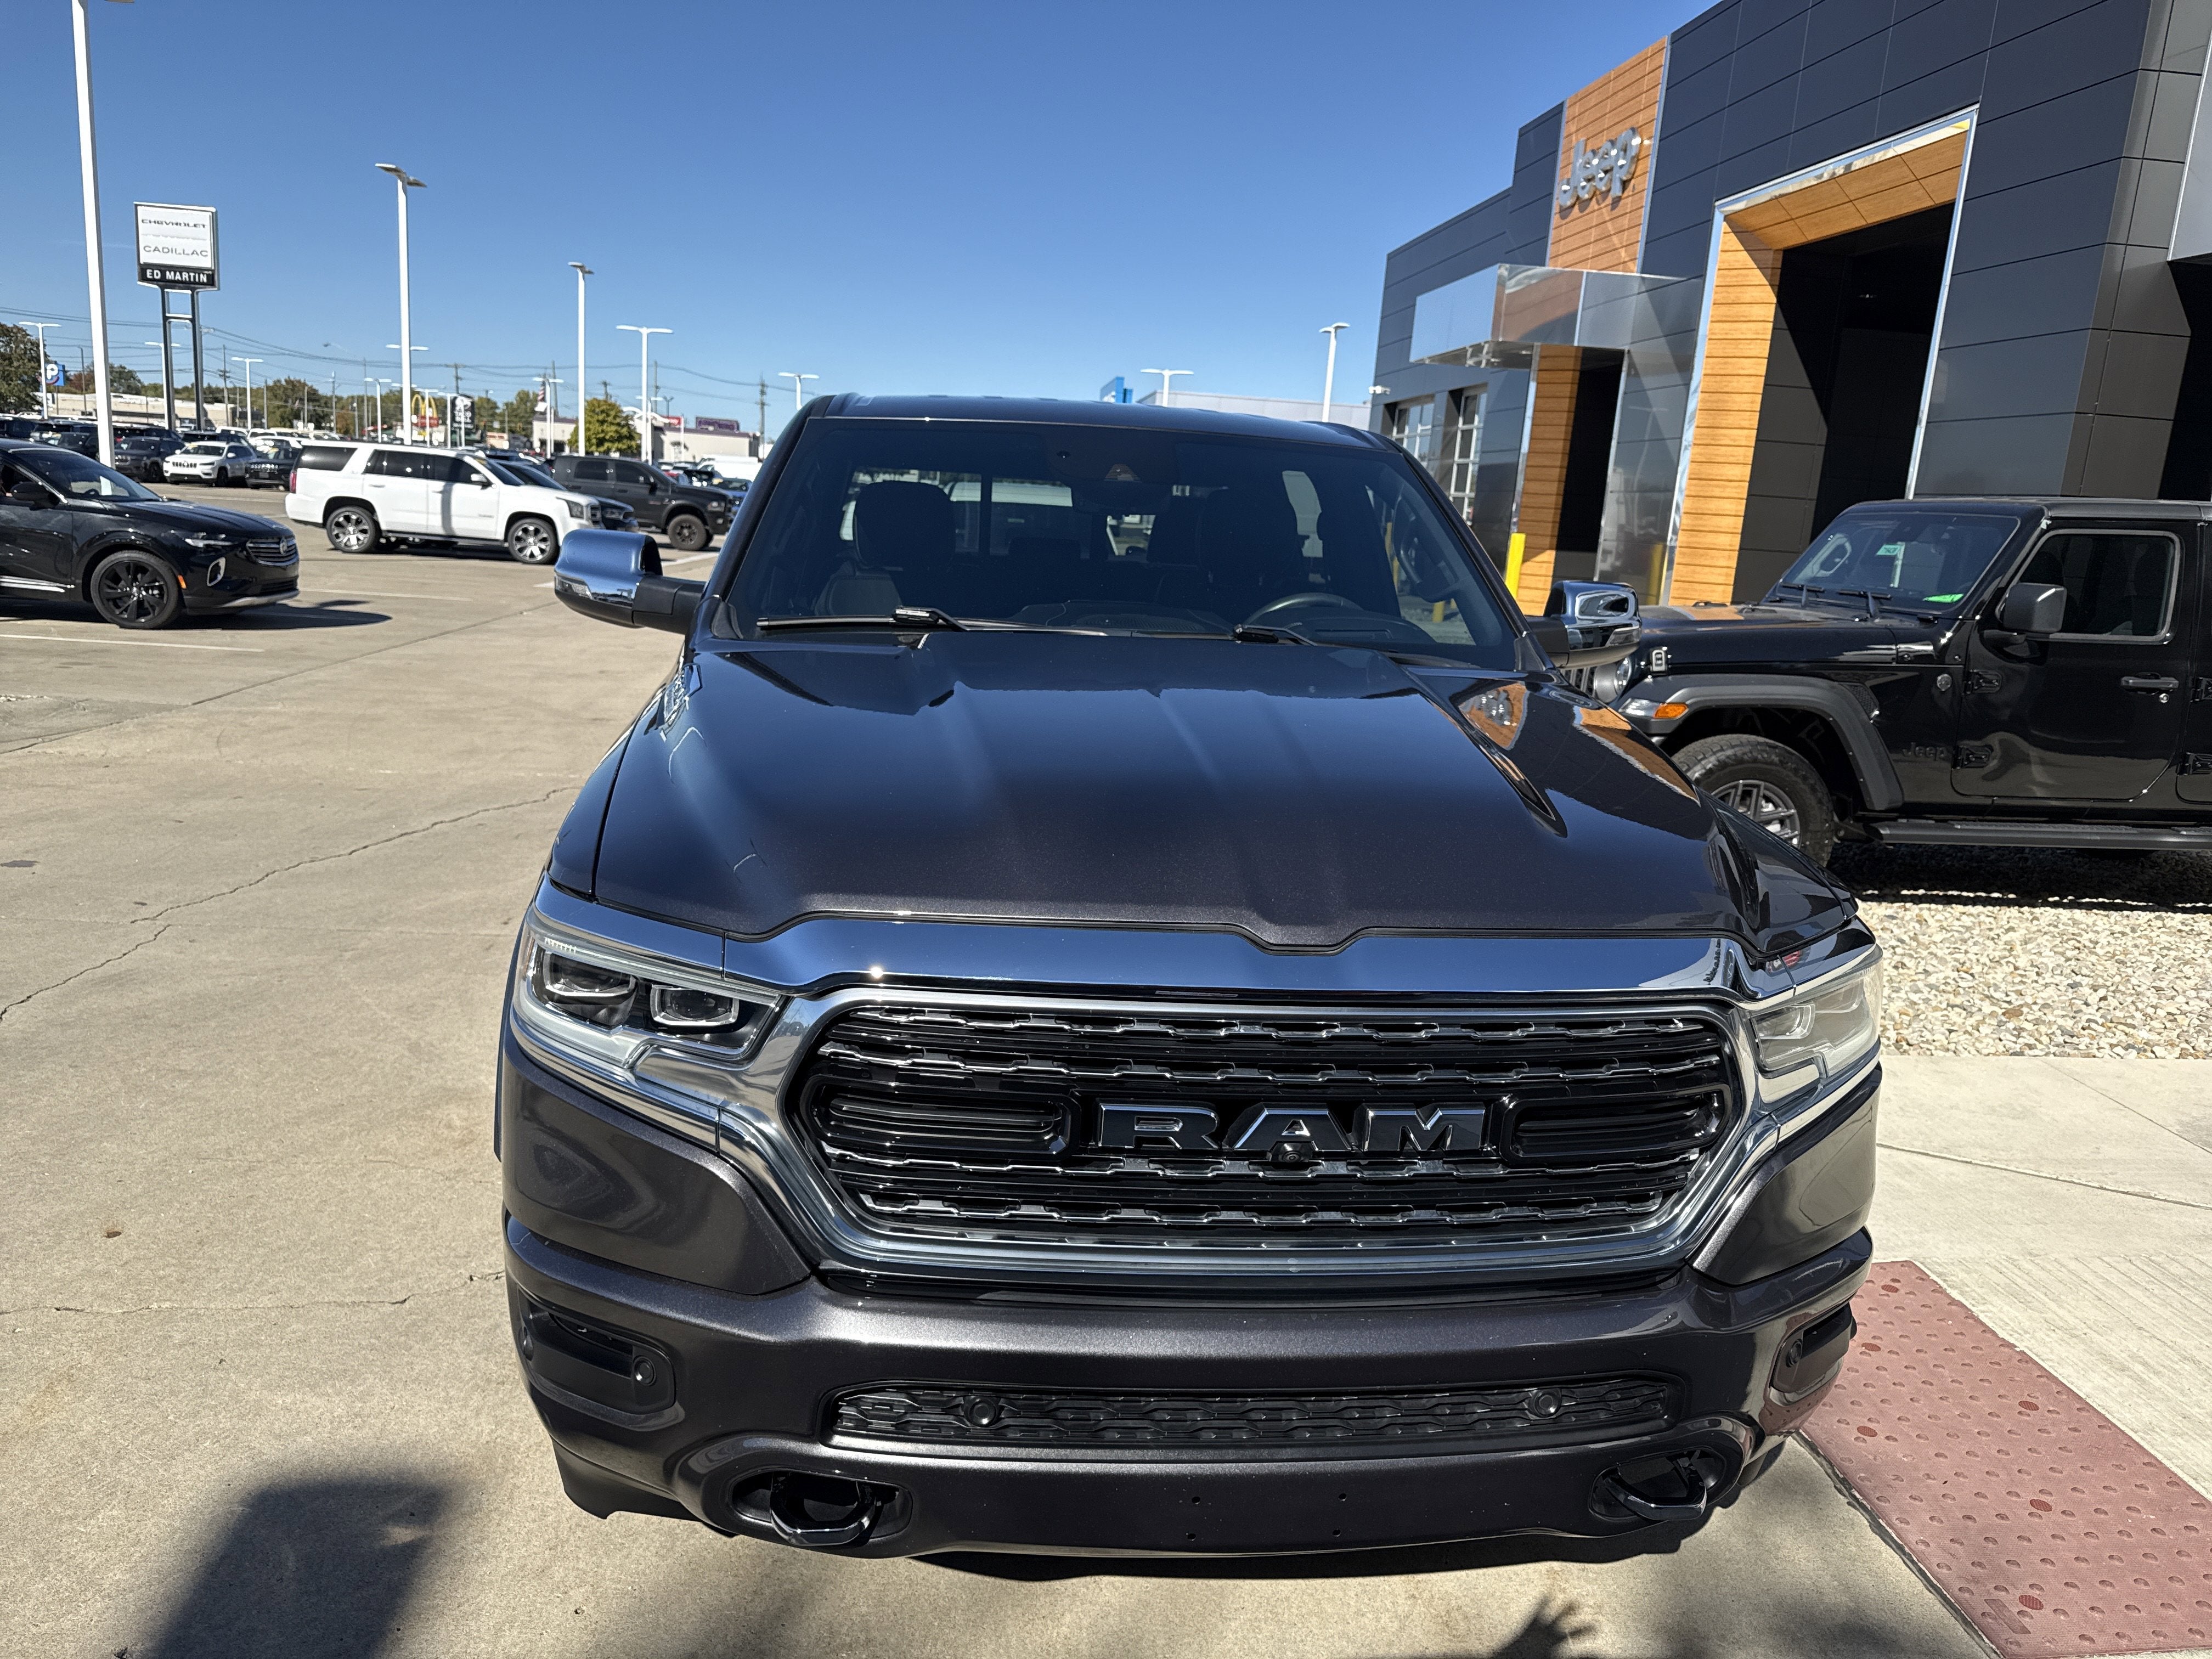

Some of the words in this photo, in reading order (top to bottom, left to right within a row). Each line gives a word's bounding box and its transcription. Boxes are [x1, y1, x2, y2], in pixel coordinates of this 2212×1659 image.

[1559, 127, 1641, 207] Jeep
[141, 218, 206, 229] CHEVROLET
[143, 245, 208, 257] CADILLAC
[146, 269, 161, 279] ED
[166, 270, 207, 283] MARTIN
[1902, 742, 1948, 761] Jeep
[1097, 1101, 1486, 1152] RAM
